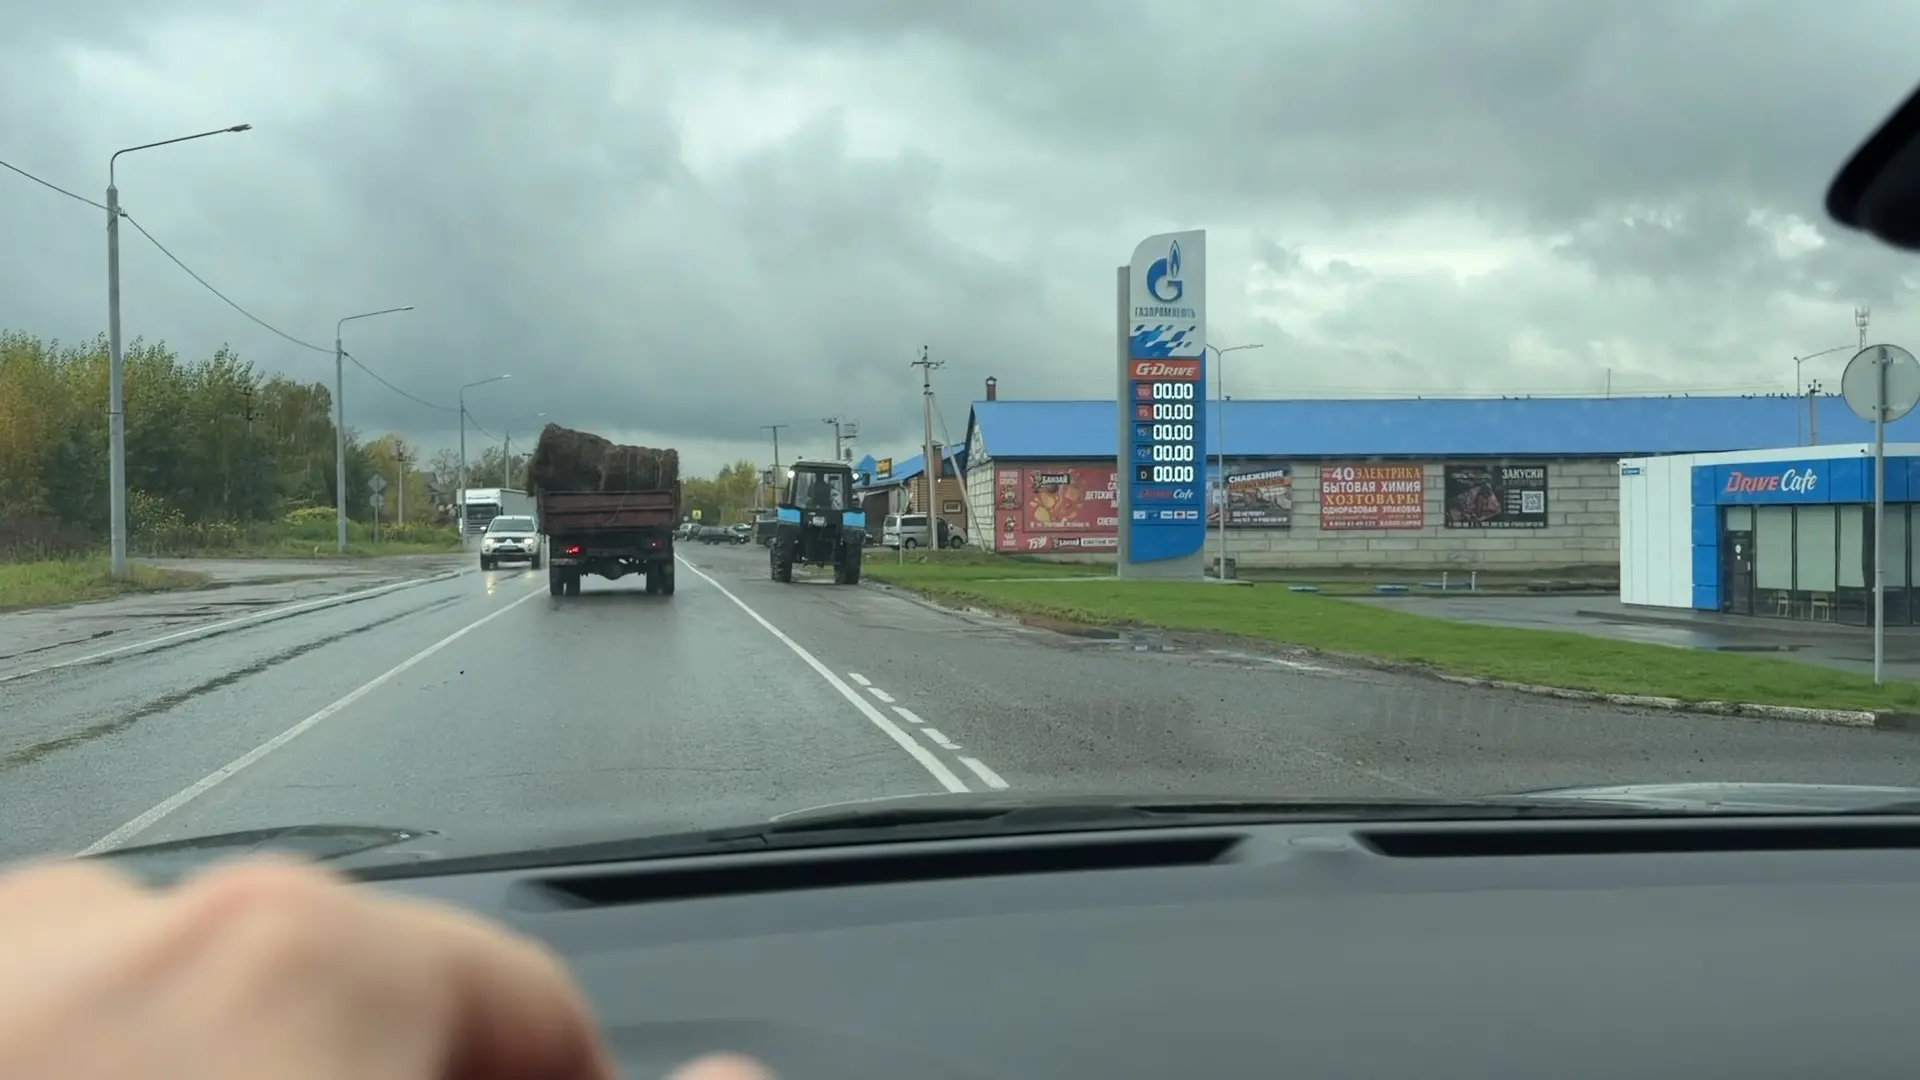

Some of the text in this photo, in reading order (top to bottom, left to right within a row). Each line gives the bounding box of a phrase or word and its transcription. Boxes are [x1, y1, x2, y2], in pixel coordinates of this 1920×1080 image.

[1135, 307, 1196, 318] ГАЗПРОМНЕФТЬ
[1153, 383, 1193, 399] 00.00
[1153, 404, 1193, 420] 00.00
[1153, 425, 1193, 440] 00.00
[1153, 445, 1193, 461] 00.00
[1140, 466, 1194, 482] D 00.00
[1332, 467, 1354, 481] 40
[1355, 467, 1420, 479] ЭЛЕКТРИКА
[1502, 468, 1544, 480] ЗАКУСКИ
[1781, 468, 1817, 494] Cafe
[1323, 481, 1421, 493] БЫТОВАЯ ХИМИЯ
[1325, 494, 1419, 505] ХОЗТОВАРЫ
[1323, 505, 1421, 514] ОДНОРАЗОВАЯ УПАКОВКА
